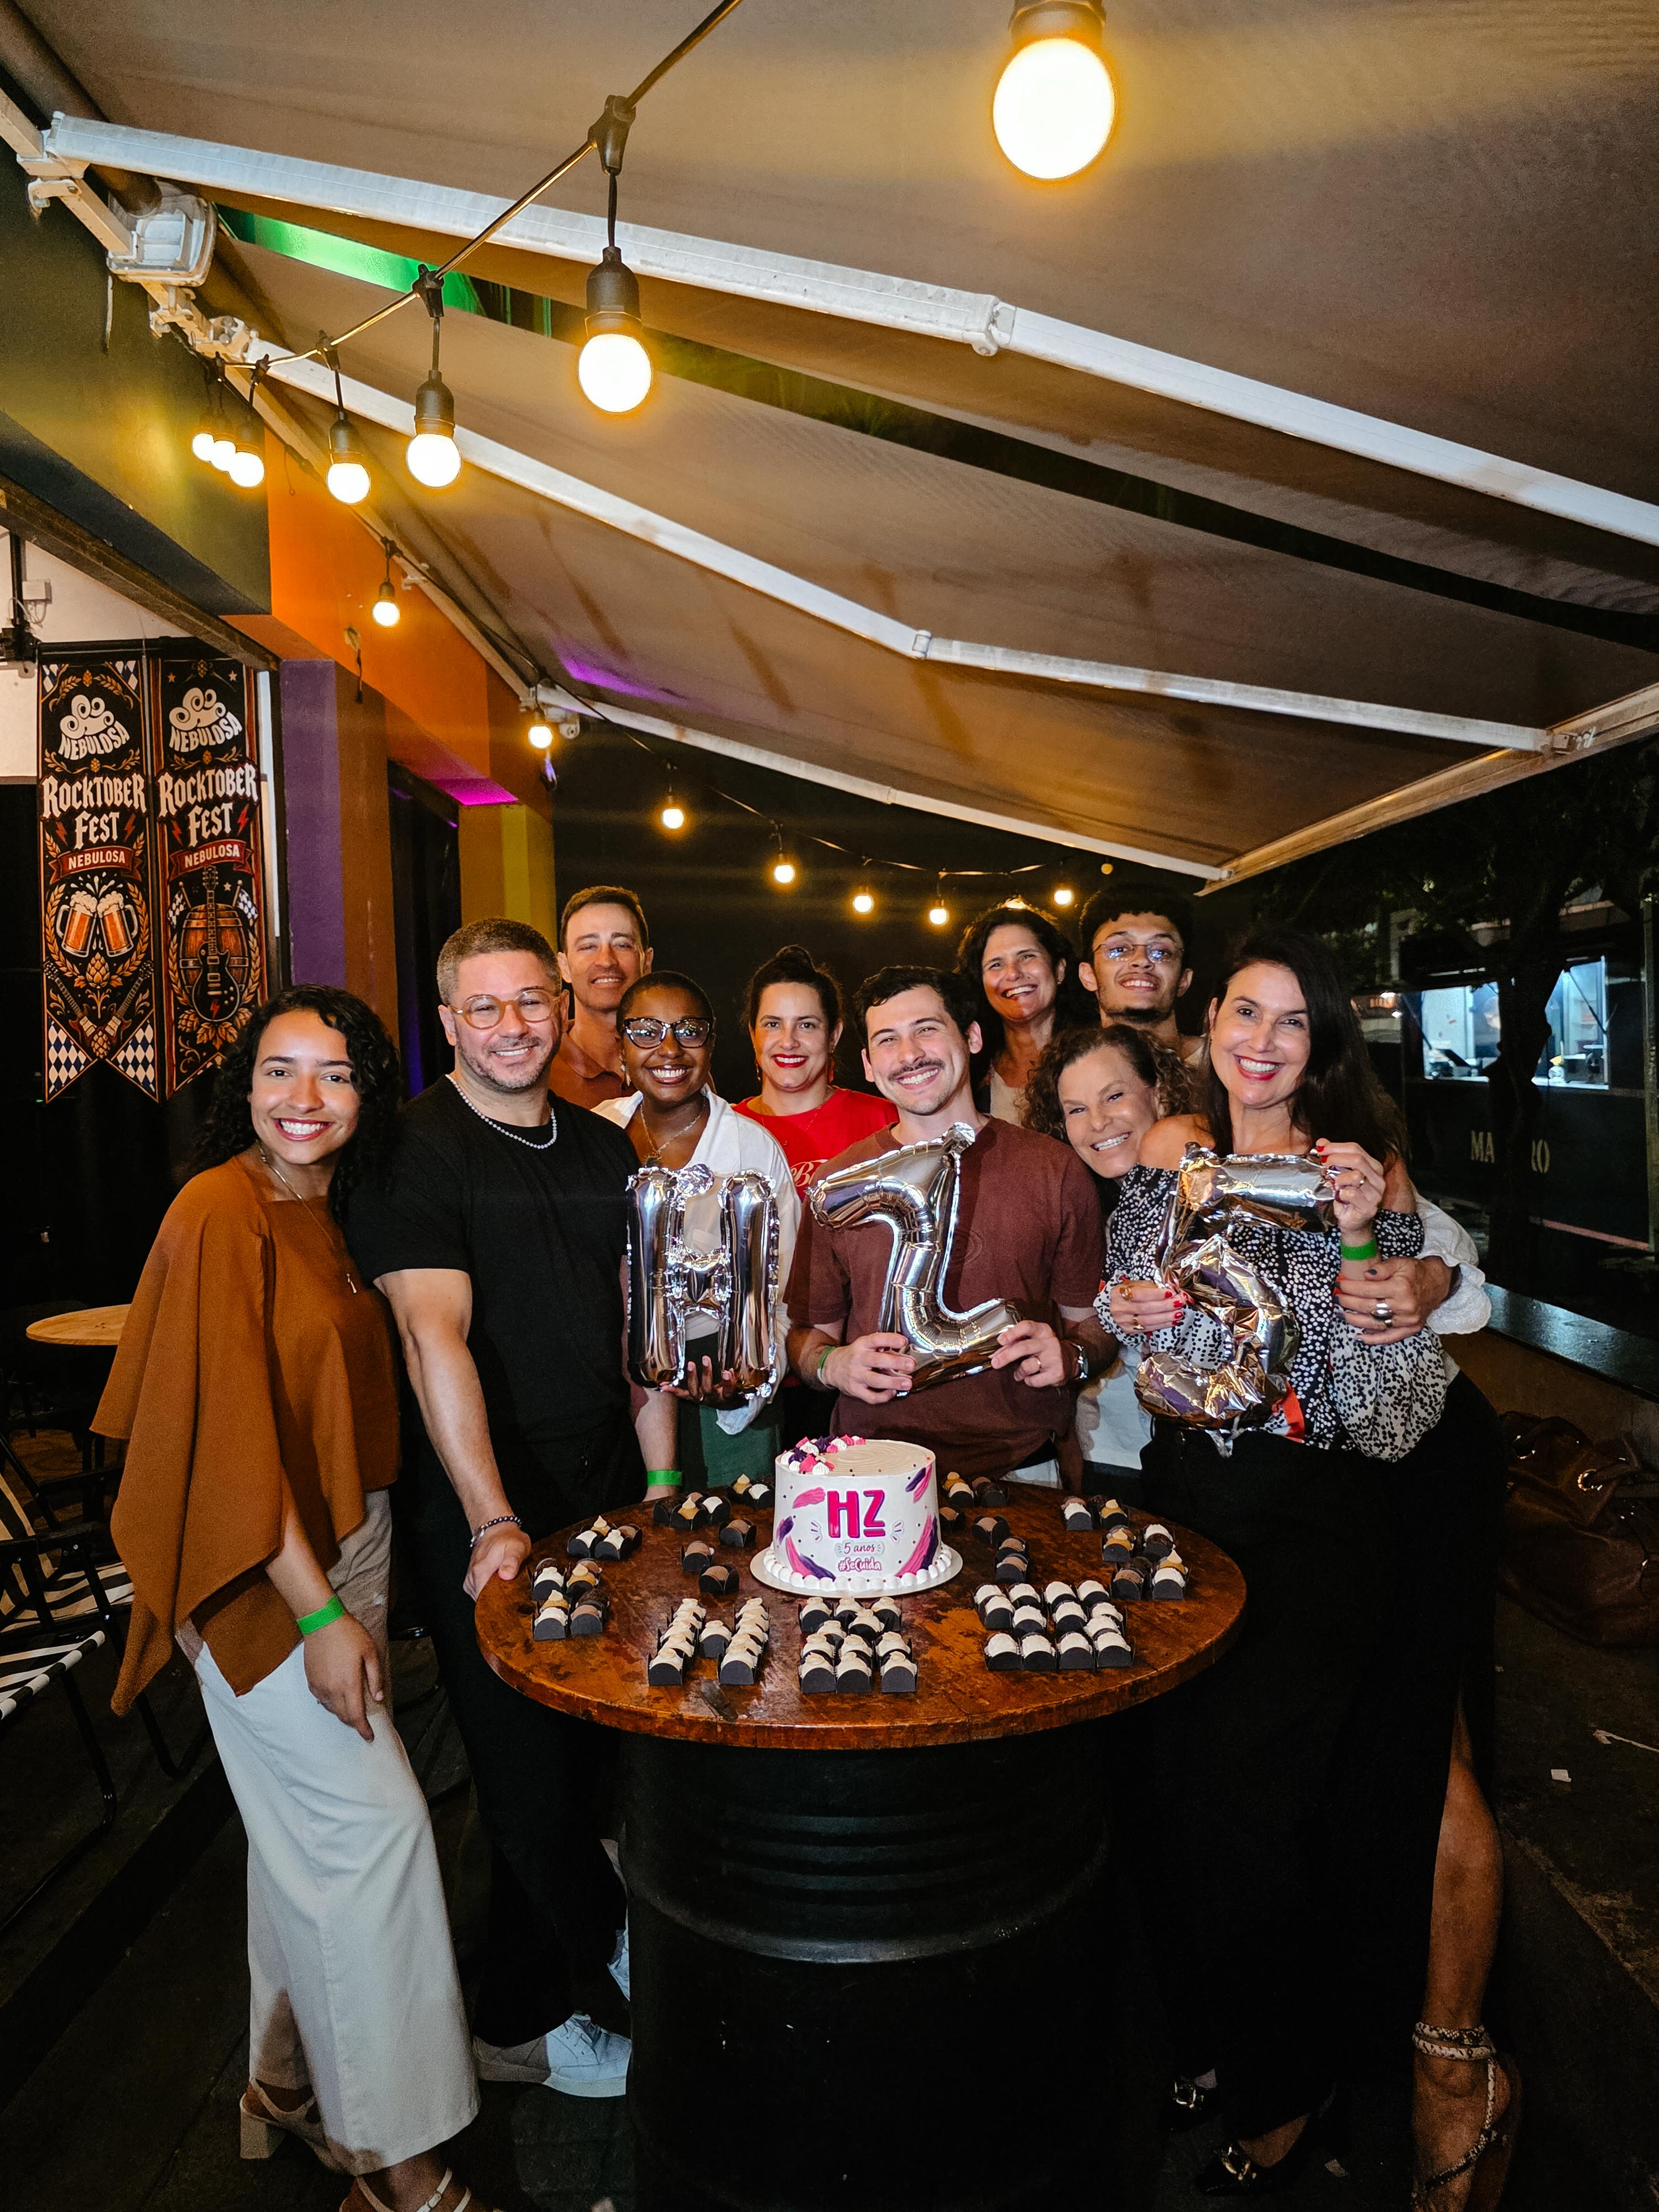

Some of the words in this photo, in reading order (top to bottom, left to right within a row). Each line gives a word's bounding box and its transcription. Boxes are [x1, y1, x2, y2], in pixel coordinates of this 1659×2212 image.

[58, 720, 131, 760] NEBULOSA
[169, 711, 243, 753] NEBULOSA
[41, 772, 148, 819] ROCKTOBER
[158, 763, 259, 820] ROCKTOBER
[74, 810, 119, 850] FEST
[187, 802, 234, 847] FEST
[67, 850, 126, 870] NEBULOSA
[184, 843, 241, 869] NEBULOSA
[627, 1164, 780, 1400] H
[827, 1489, 886, 1538] HZ
[838, 1556, 882, 1572] #SeCuida
[844, 1542, 852, 1554] 5
[853, 1543, 876, 1553] anos
